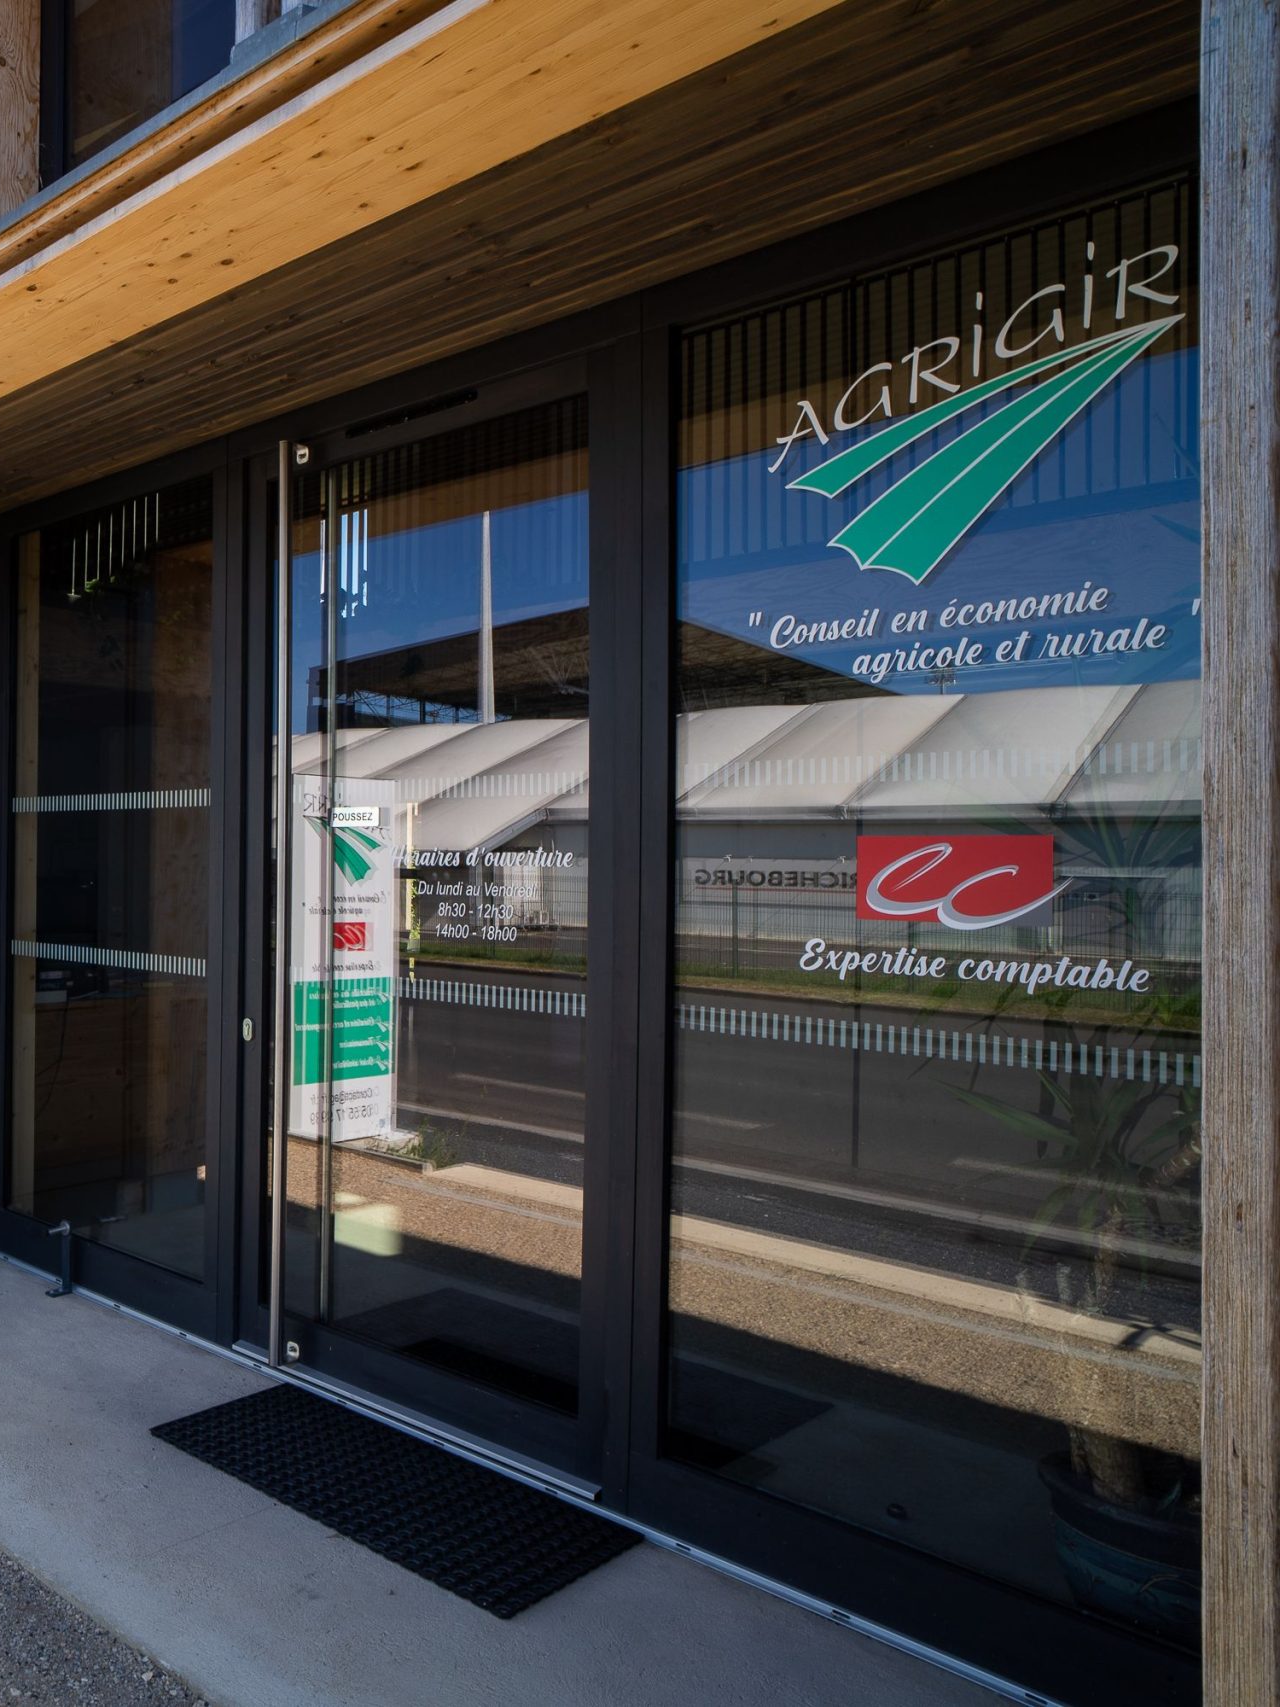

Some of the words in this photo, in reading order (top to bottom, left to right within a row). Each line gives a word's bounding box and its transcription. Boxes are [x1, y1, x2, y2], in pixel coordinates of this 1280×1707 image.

[769, 609, 881, 650] Conseil
[890, 606, 927, 635] en
[938, 580, 1109, 625] économie
[852, 639, 983, 684] agricole
[995, 631, 1025, 662] et
[1038, 618, 1167, 659] rurale
[332, 811, 374, 822] POUSSEZ
[392, 848, 461, 869] Horaires
[467, 846, 575, 869] d'ouverture
[418, 882, 434, 896] Du
[436, 882, 464, 897] lundi
[466, 886, 482, 897] au
[484, 884, 538, 898] Vendredi
[438, 904, 466, 918] 8h30
[477, 904, 514, 919] 12h30
[435, 924, 469, 939] 14h00
[481, 925, 518, 942] 18h00
[799, 937, 945, 981] Expertise
[958, 956, 1150, 995] comptable
